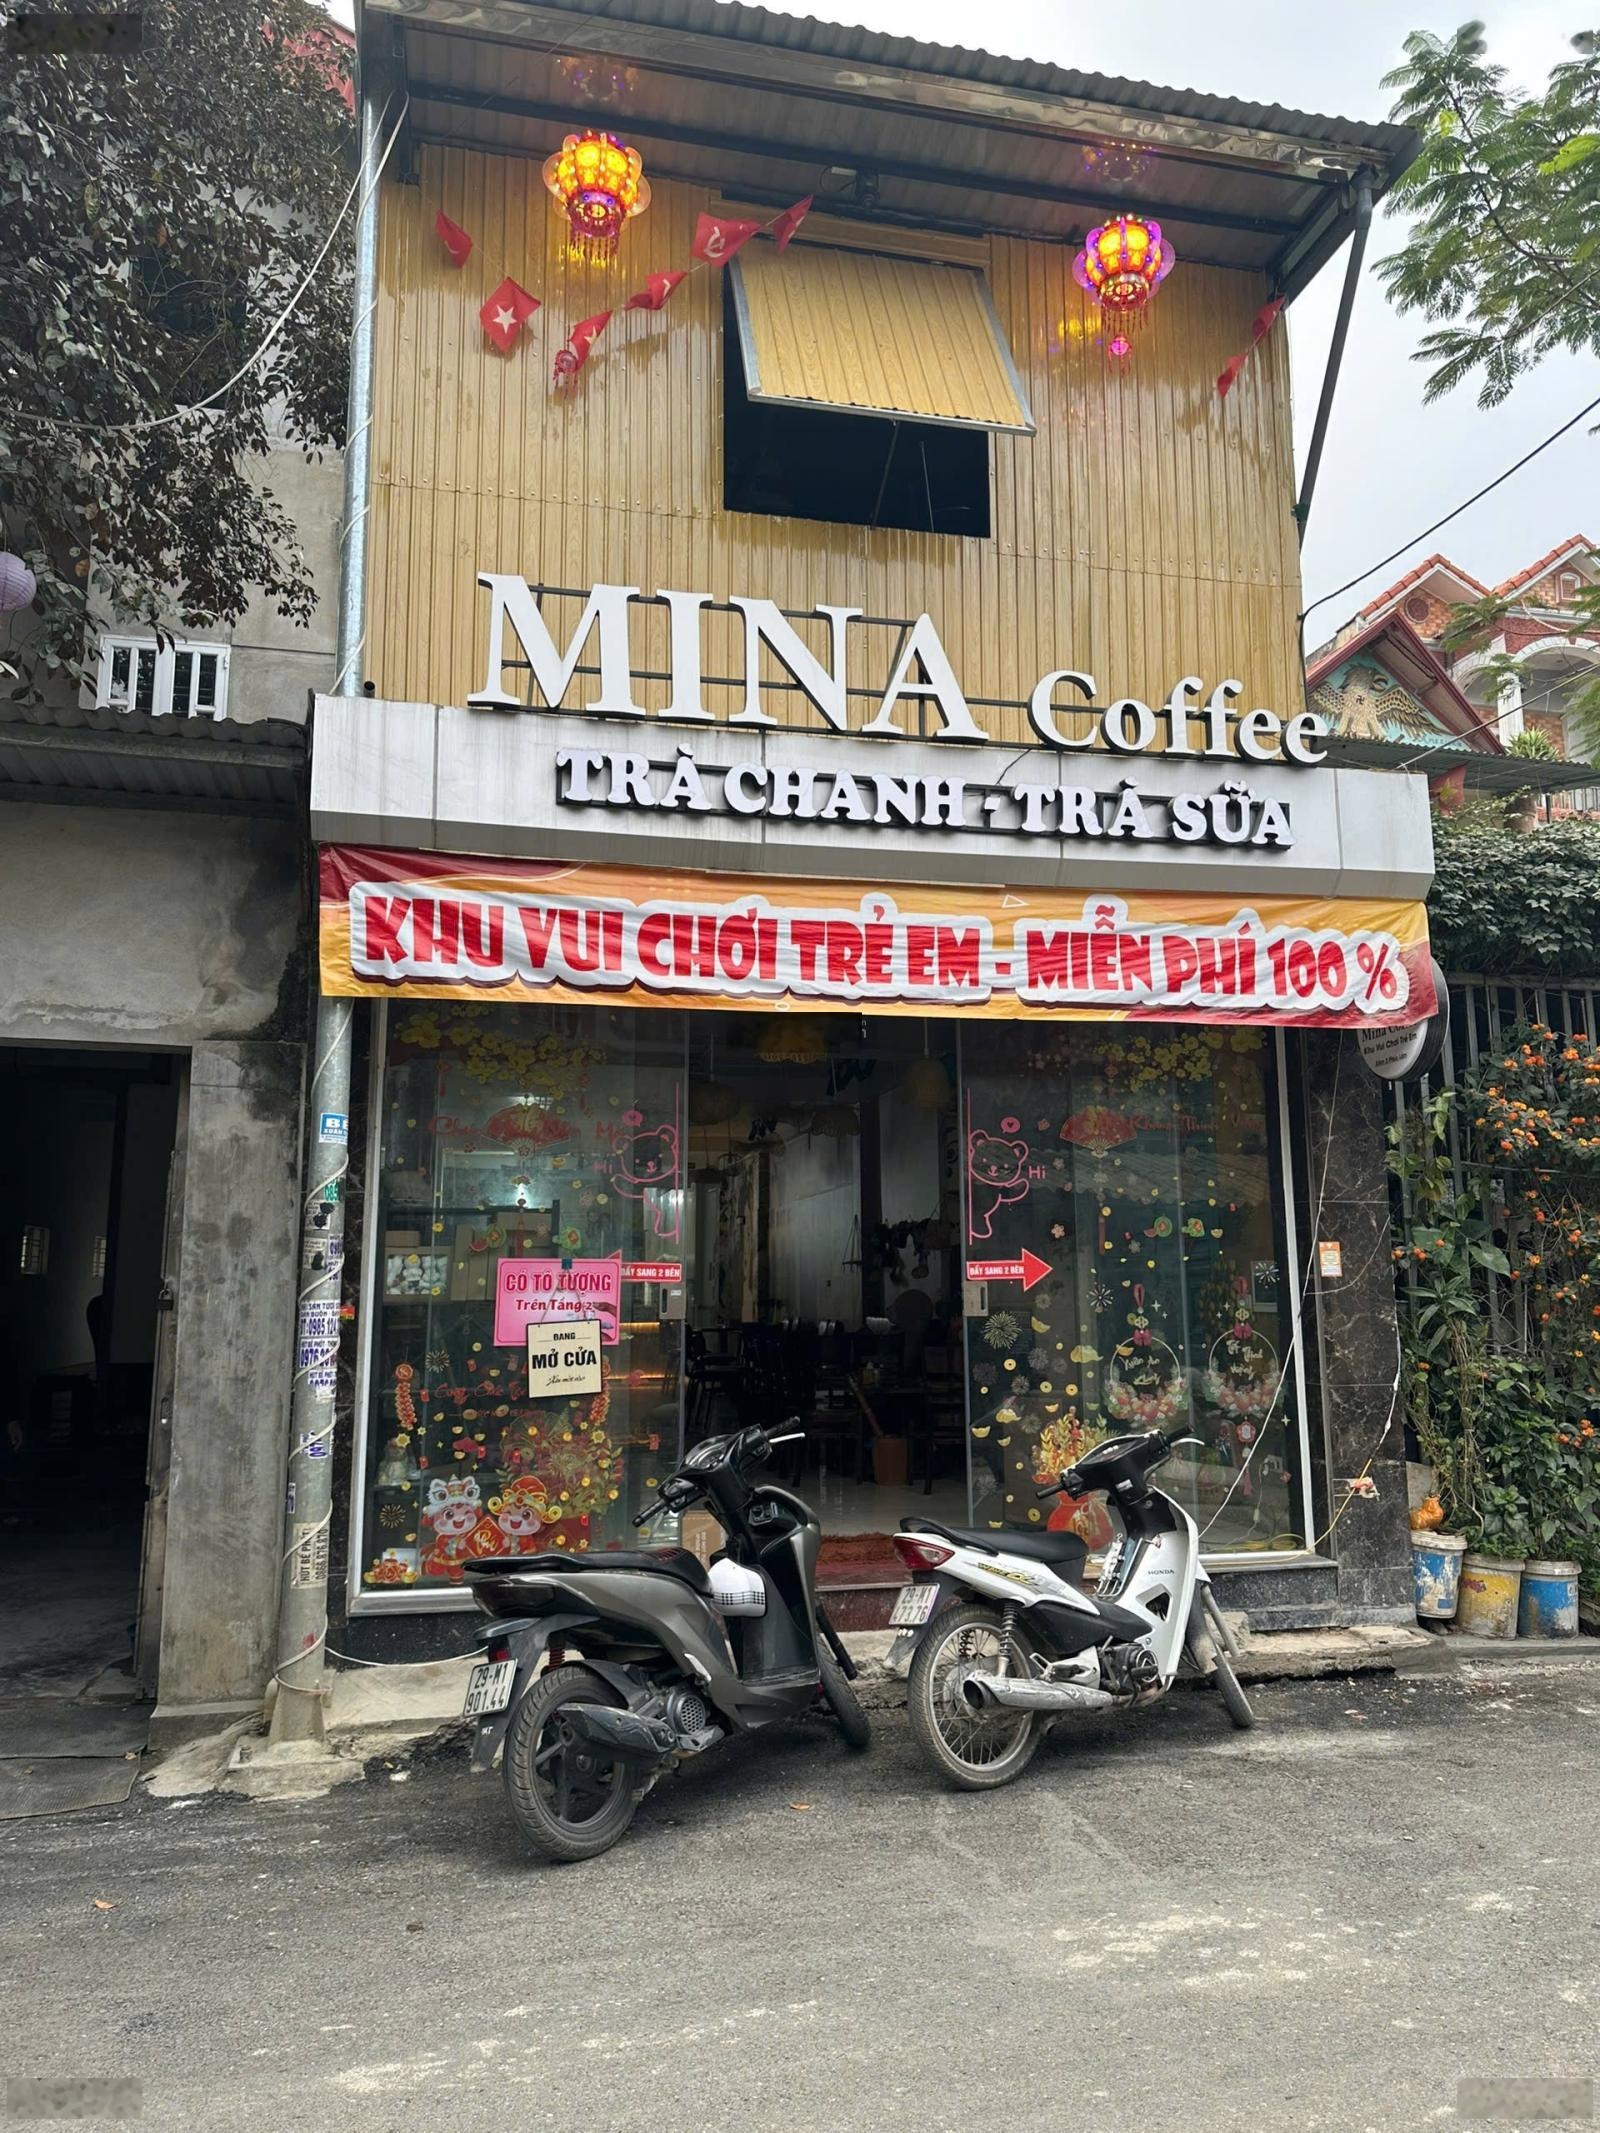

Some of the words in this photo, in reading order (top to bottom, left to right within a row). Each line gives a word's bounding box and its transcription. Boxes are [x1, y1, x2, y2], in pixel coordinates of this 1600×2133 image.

[468, 572, 989, 742] MINA
[1027, 670, 1329, 764] Coffee
[557, 744, 712, 811] TRÀ
[724, 762, 966, 828] CHANH
[1014, 777, 1154, 839] TRÀ
[1171, 779, 1295, 849] SỮA
[365, 896, 505, 967] KHU
[518, 908, 623, 972] VUI
[790, 905, 894, 986] TRẺ
[906, 923, 980, 988] EM
[1026, 905, 1151, 992] MIỄN
[1162, 922, 1256, 996] PHÍ
[1267, 940, 1347, 999] 100
[1357, 942, 1398, 1001] %
[1028, 1166, 1046, 1179] Hi
[506, 1269, 527, 1291] CÓ
[534, 1269, 552, 1291] TÔ
[559, 1272, 611, 1295] TƯỢNG
[636, 1268, 657, 1276] SANG
[658, 1269, 664, 1277] 2
[516, 1298, 547, 1310] Trên
[553, 1333, 576, 1342] ĐANG
[532, 1348, 559, 1369] MỞ
[564, 1346, 597, 1367] CỬA
[474, 1663, 509, 1689] 29-M1
[466, 1686, 506, 1714] 901.44
